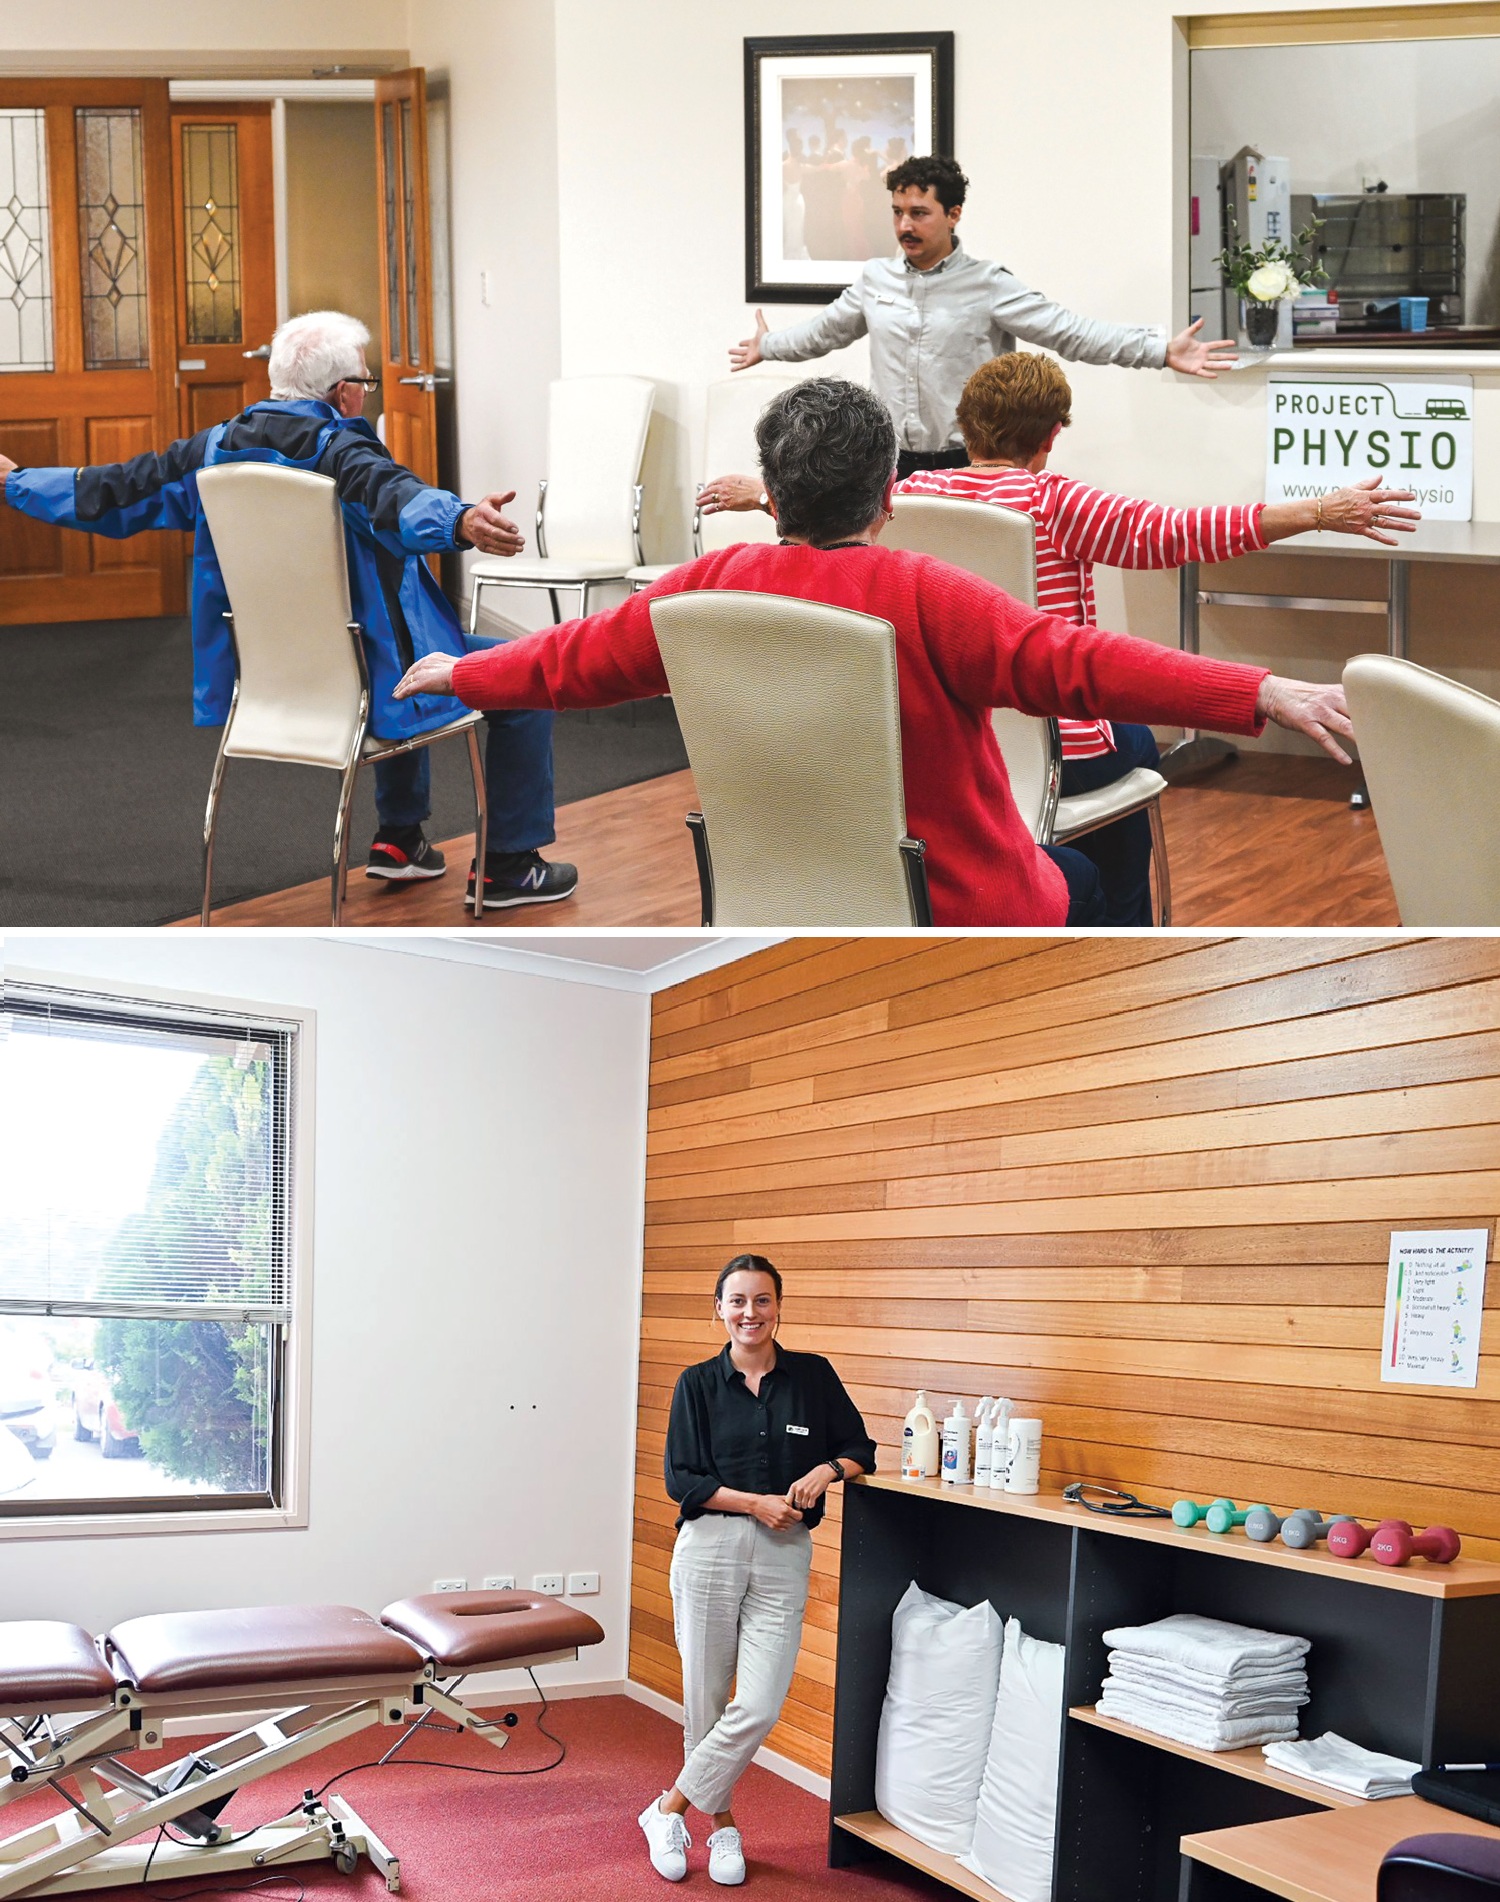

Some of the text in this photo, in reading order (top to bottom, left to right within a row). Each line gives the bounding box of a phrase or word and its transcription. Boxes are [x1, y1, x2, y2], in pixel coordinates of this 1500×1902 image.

[1276, 394, 1384, 415] PROJECT
[1274, 427, 1456, 470] PHYSIO
[520, 866, 546, 890] N
[1332, 1535, 1347, 1544] 2KG
[1377, 1543, 1393, 1552] 2KG
